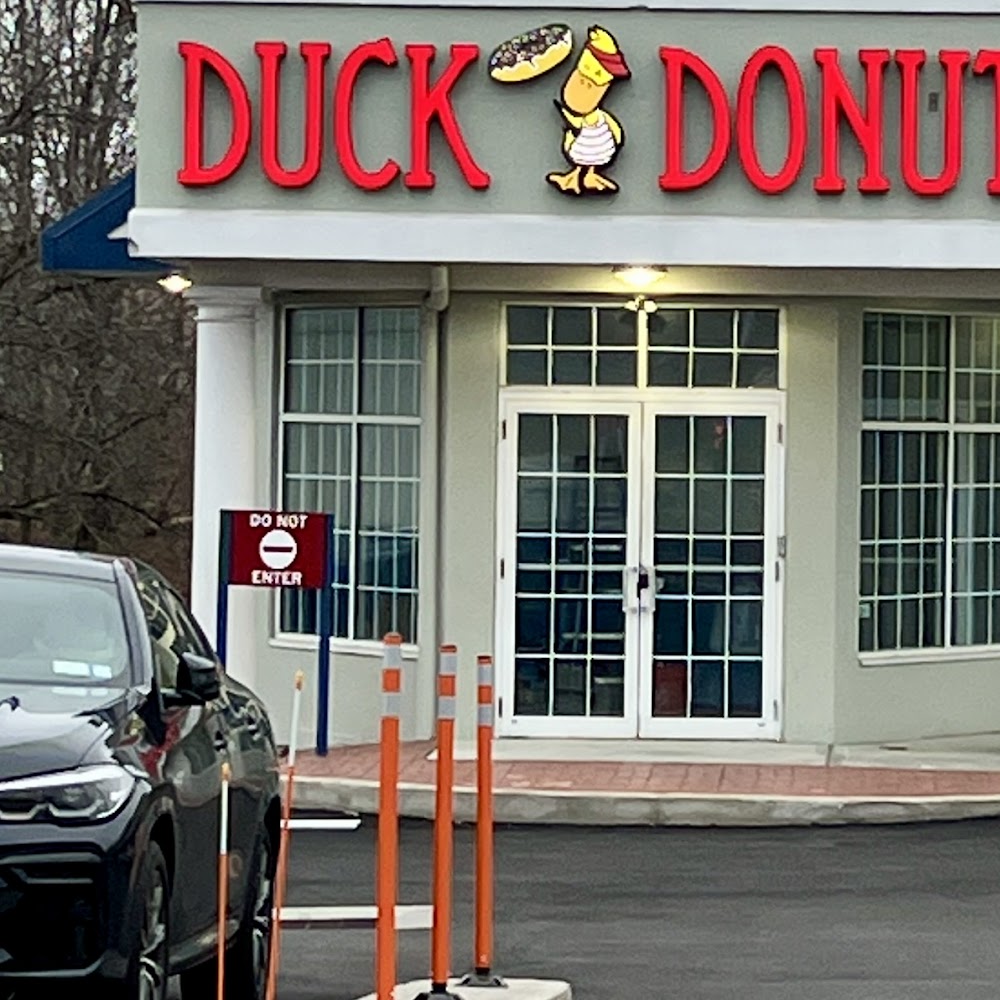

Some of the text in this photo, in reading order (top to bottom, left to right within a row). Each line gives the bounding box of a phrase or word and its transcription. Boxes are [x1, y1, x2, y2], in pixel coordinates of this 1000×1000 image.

[178, 38, 490, 190] DUCK
[249, 513, 308, 529] DO NOT
[251, 570, 302, 585] ENTER
